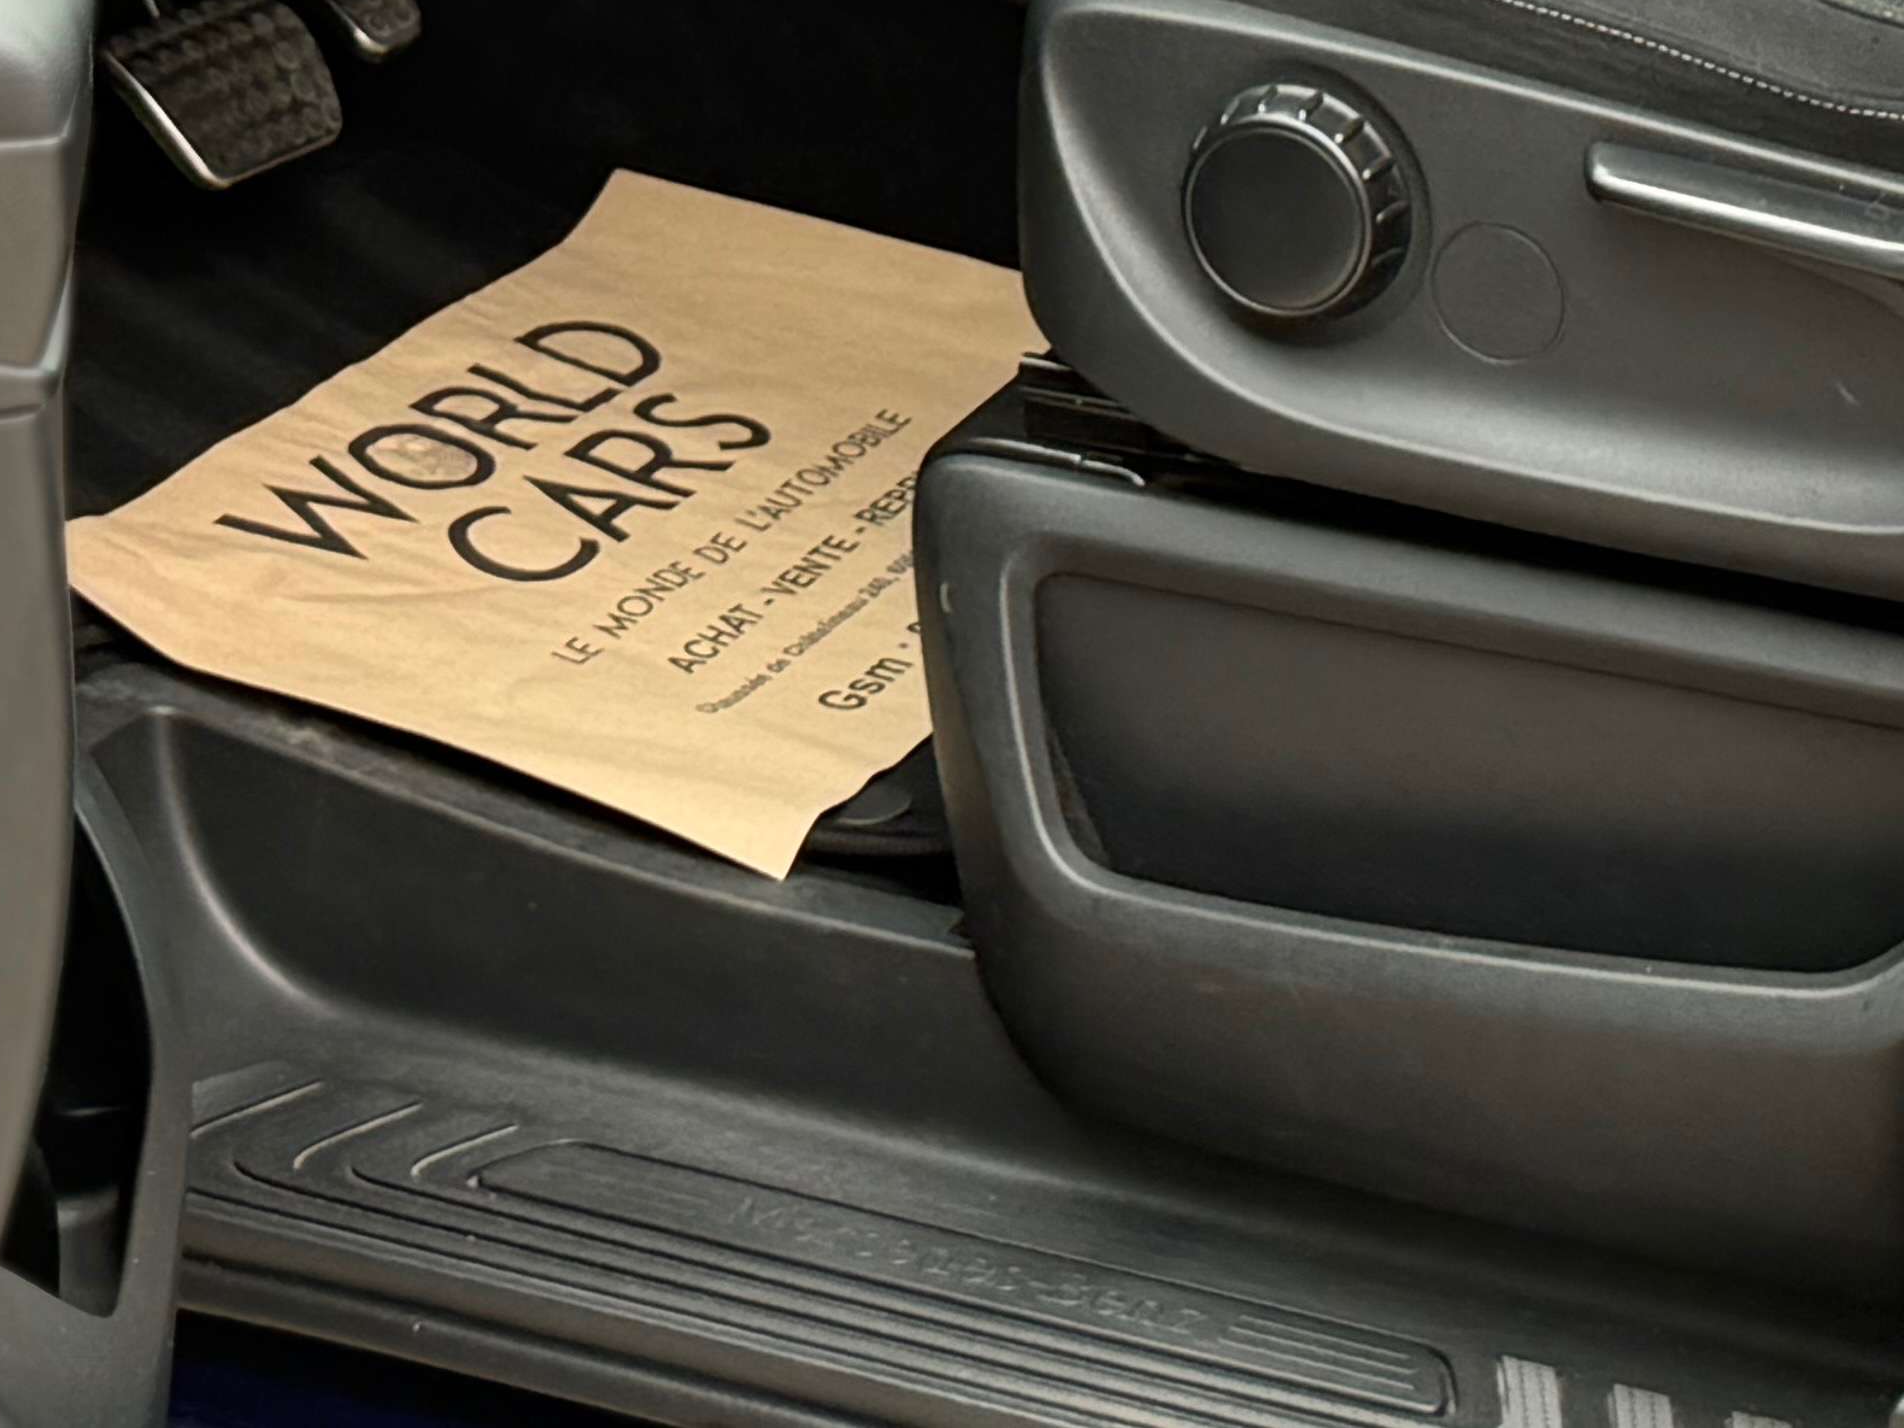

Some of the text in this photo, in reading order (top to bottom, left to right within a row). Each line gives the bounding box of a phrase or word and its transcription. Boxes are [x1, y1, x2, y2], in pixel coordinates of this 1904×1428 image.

[213, 320, 661, 561] WORLD
[447, 393, 771, 582] CARS
[551, 409, 912, 665] LE MONDE DE L'AUTOMOBILE
[667, 603, 764, 675] ACHAT
[760, 534, 861, 597] VENTE
[817, 656, 915, 712] Gsm
